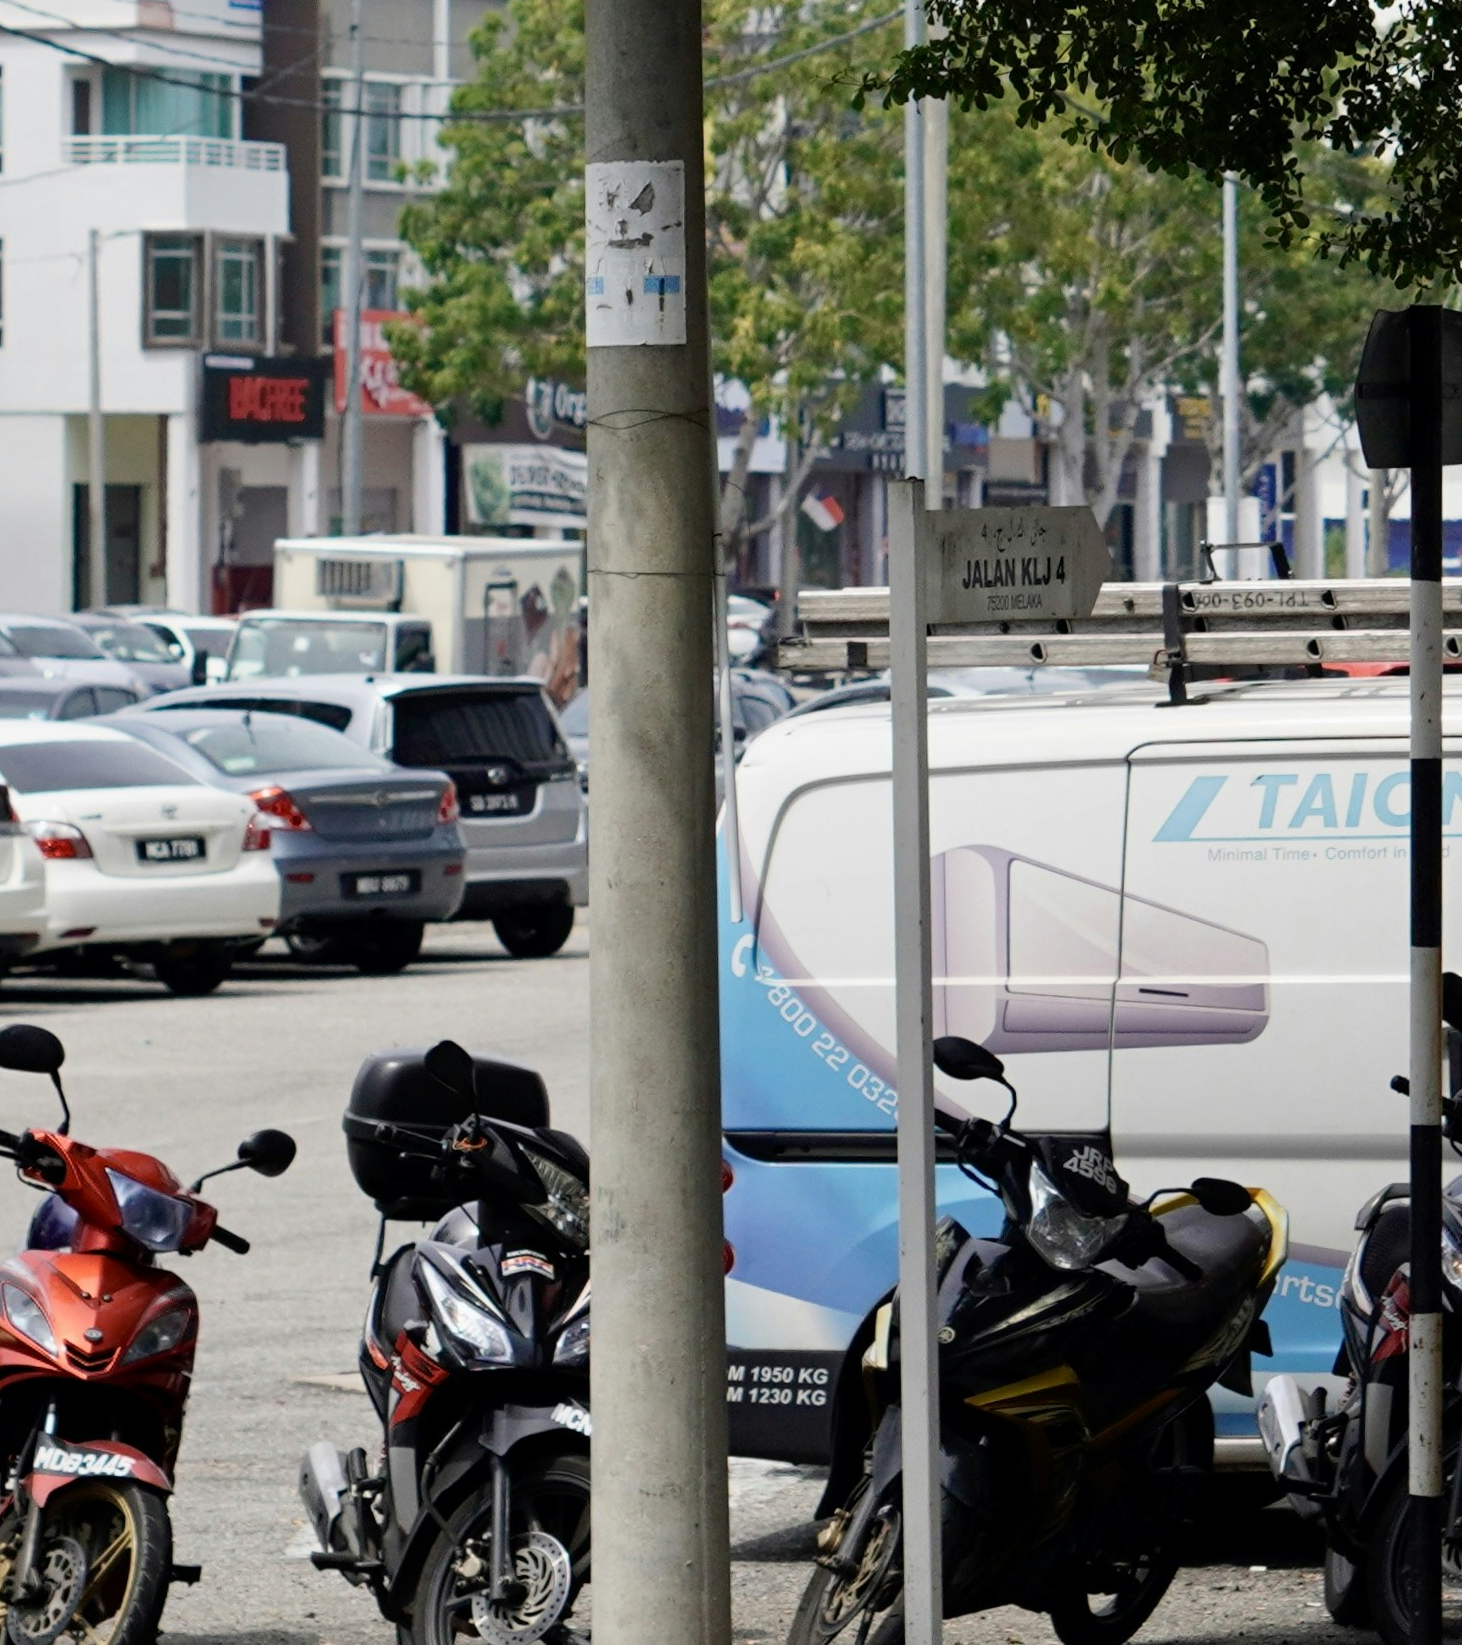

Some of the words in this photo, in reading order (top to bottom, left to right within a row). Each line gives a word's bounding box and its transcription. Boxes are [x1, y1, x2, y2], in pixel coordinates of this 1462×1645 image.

[962, 558, 1015, 589] JALAN
[1021, 557, 1051, 586] KLJ
[1056, 556, 1065, 585] 4
[987, 596, 1009, 611] 75200
[1011, 594, 1043, 610] MELAKA
[1207, 848, 1267, 862] Minimal
[1324, 844, 1388, 860] Comfort
[1393, 845, 1407, 859] in
[810, 1033, 850, 1072] 22
[750, 1366, 794, 1384] 1950
[798, 1367, 829, 1385] KG
[748, 1387, 793, 1405] 1230
[796, 1389, 827, 1406] KG
